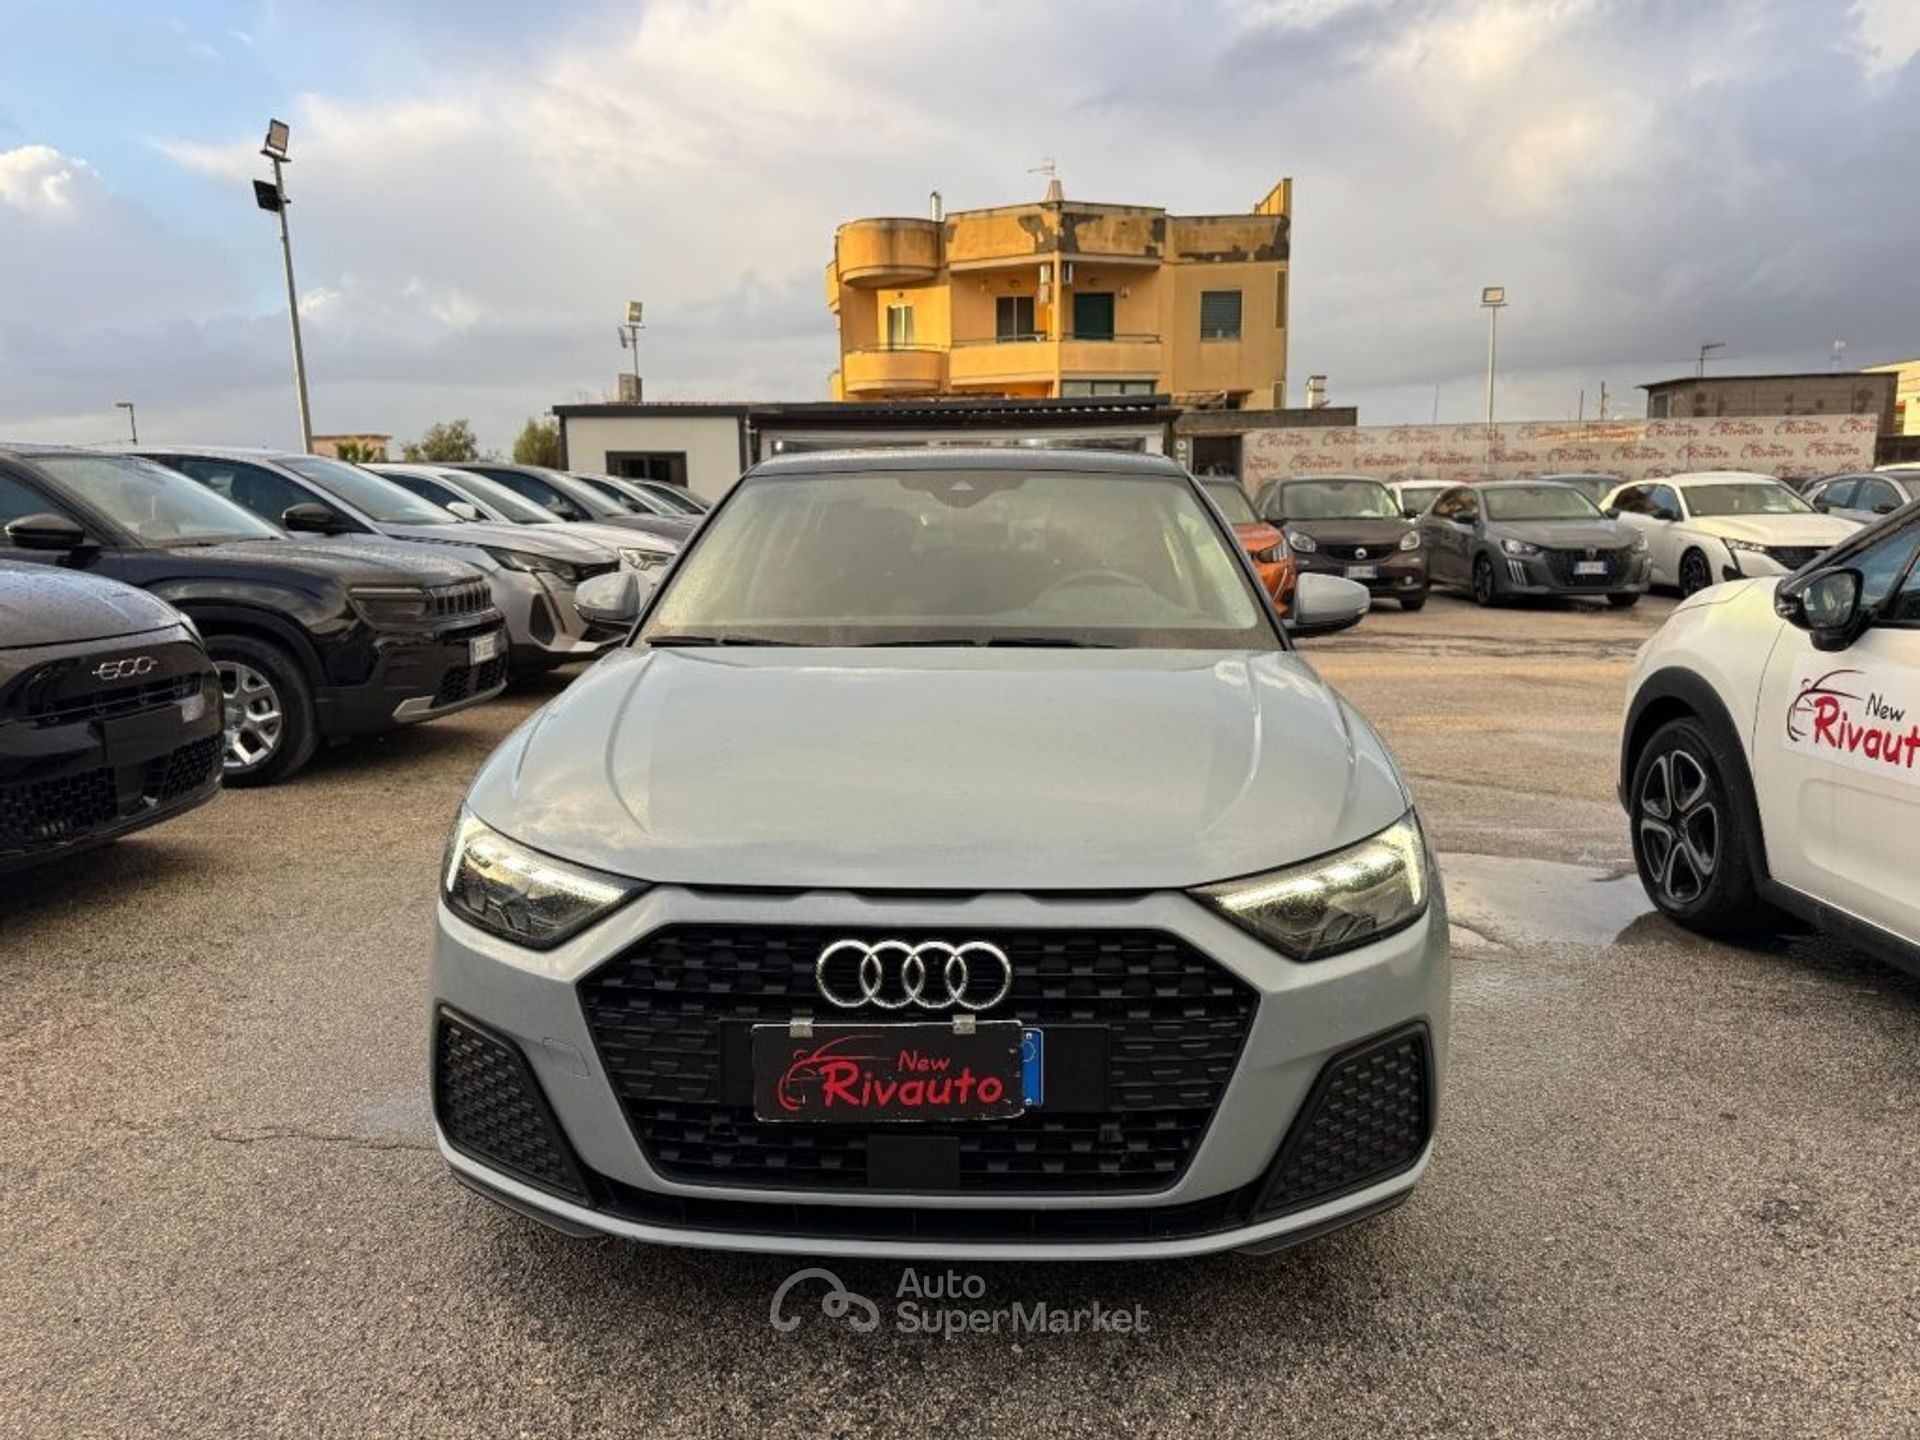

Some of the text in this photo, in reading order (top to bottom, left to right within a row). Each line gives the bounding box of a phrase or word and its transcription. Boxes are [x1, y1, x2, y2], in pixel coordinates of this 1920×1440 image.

[1656, 424, 1699, 437] Rivauto
[1720, 422, 1763, 435] Rivauto
[1786, 421, 1829, 435] Rivauto
[1850, 420, 1876, 433] Riva
[1559, 448, 1600, 461] Rivauto
[1751, 444, 1793, 457] Rivauto
[1816, 443, 1859, 457] Rivauto
[100, 656, 152, 680] 600
[1866, 693, 1905, 721] New
[1814, 695, 1920, 768] Rivaut
[899, 1050, 950, 1071] New
[820, 1061, 1002, 1108] Rivauto
